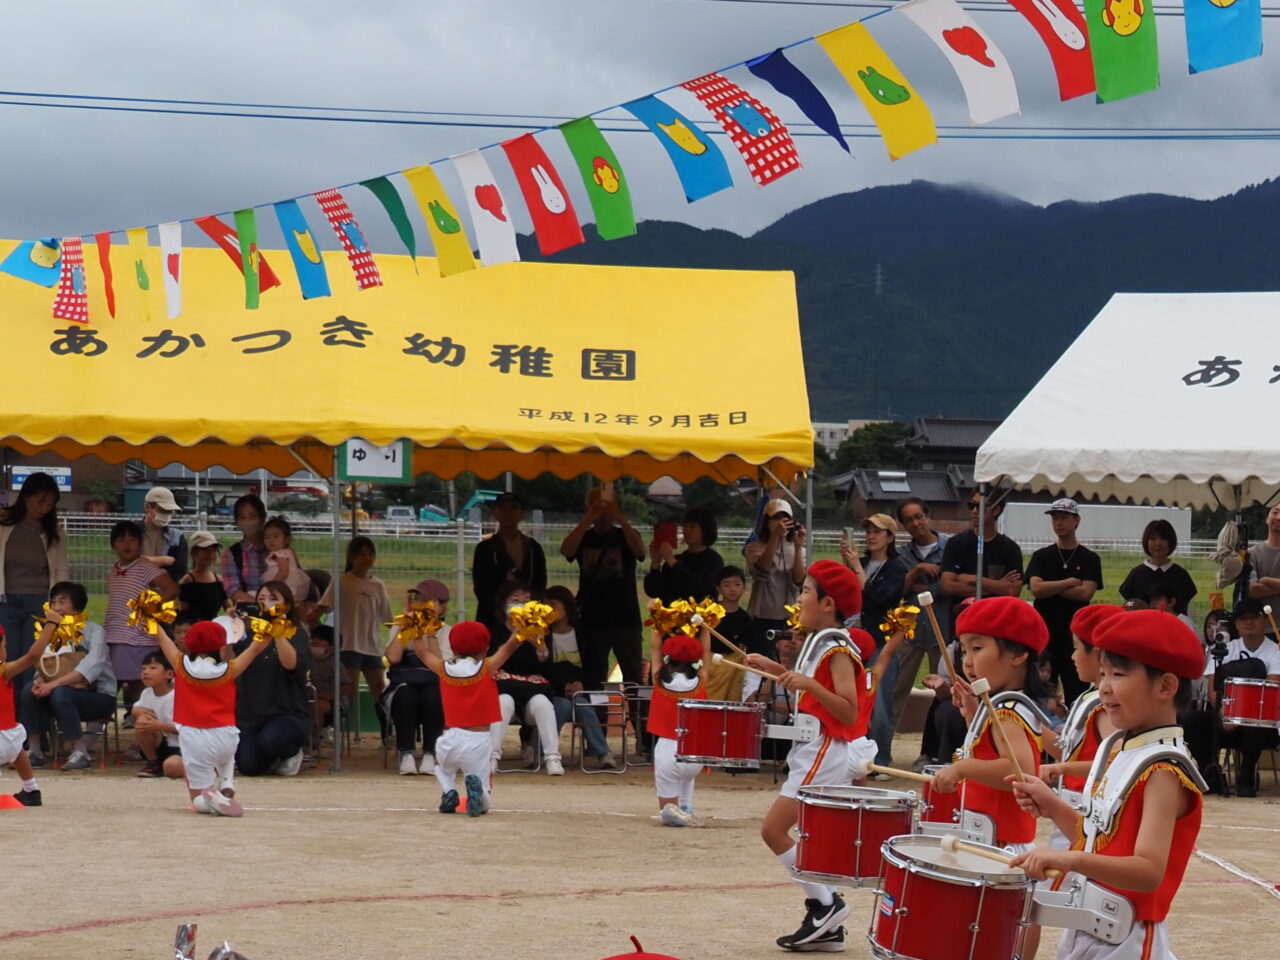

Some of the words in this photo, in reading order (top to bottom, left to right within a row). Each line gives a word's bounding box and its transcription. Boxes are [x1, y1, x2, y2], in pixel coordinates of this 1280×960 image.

[50, 316, 637, 381] あかつき幼稚園
[518, 407, 748, 429] 平成12年9月吉日
